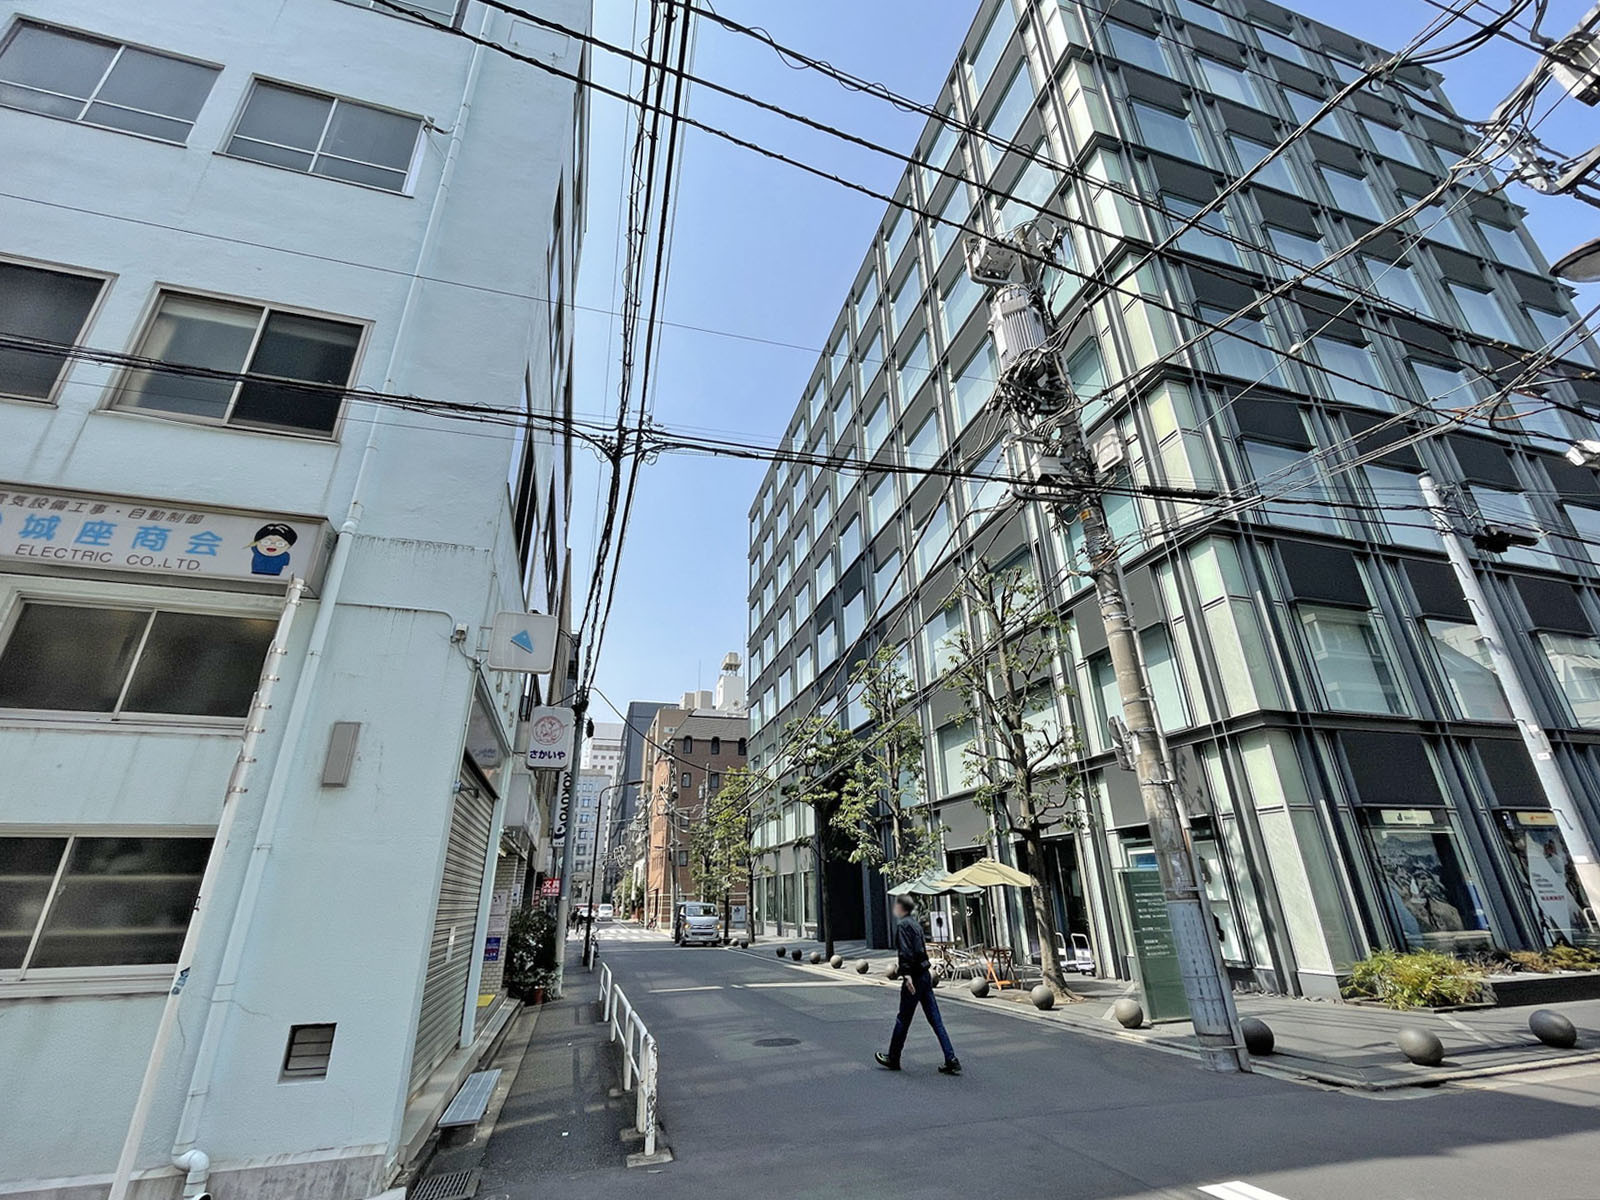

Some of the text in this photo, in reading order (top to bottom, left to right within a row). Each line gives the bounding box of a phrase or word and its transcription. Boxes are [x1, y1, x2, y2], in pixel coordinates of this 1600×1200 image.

[0, 511, 223, 557] 城座商会
[15, 543, 113, 563] ELECTRIC
[529, 749, 566, 760] さかいや
[559, 772, 572, 822] KOKUYO
